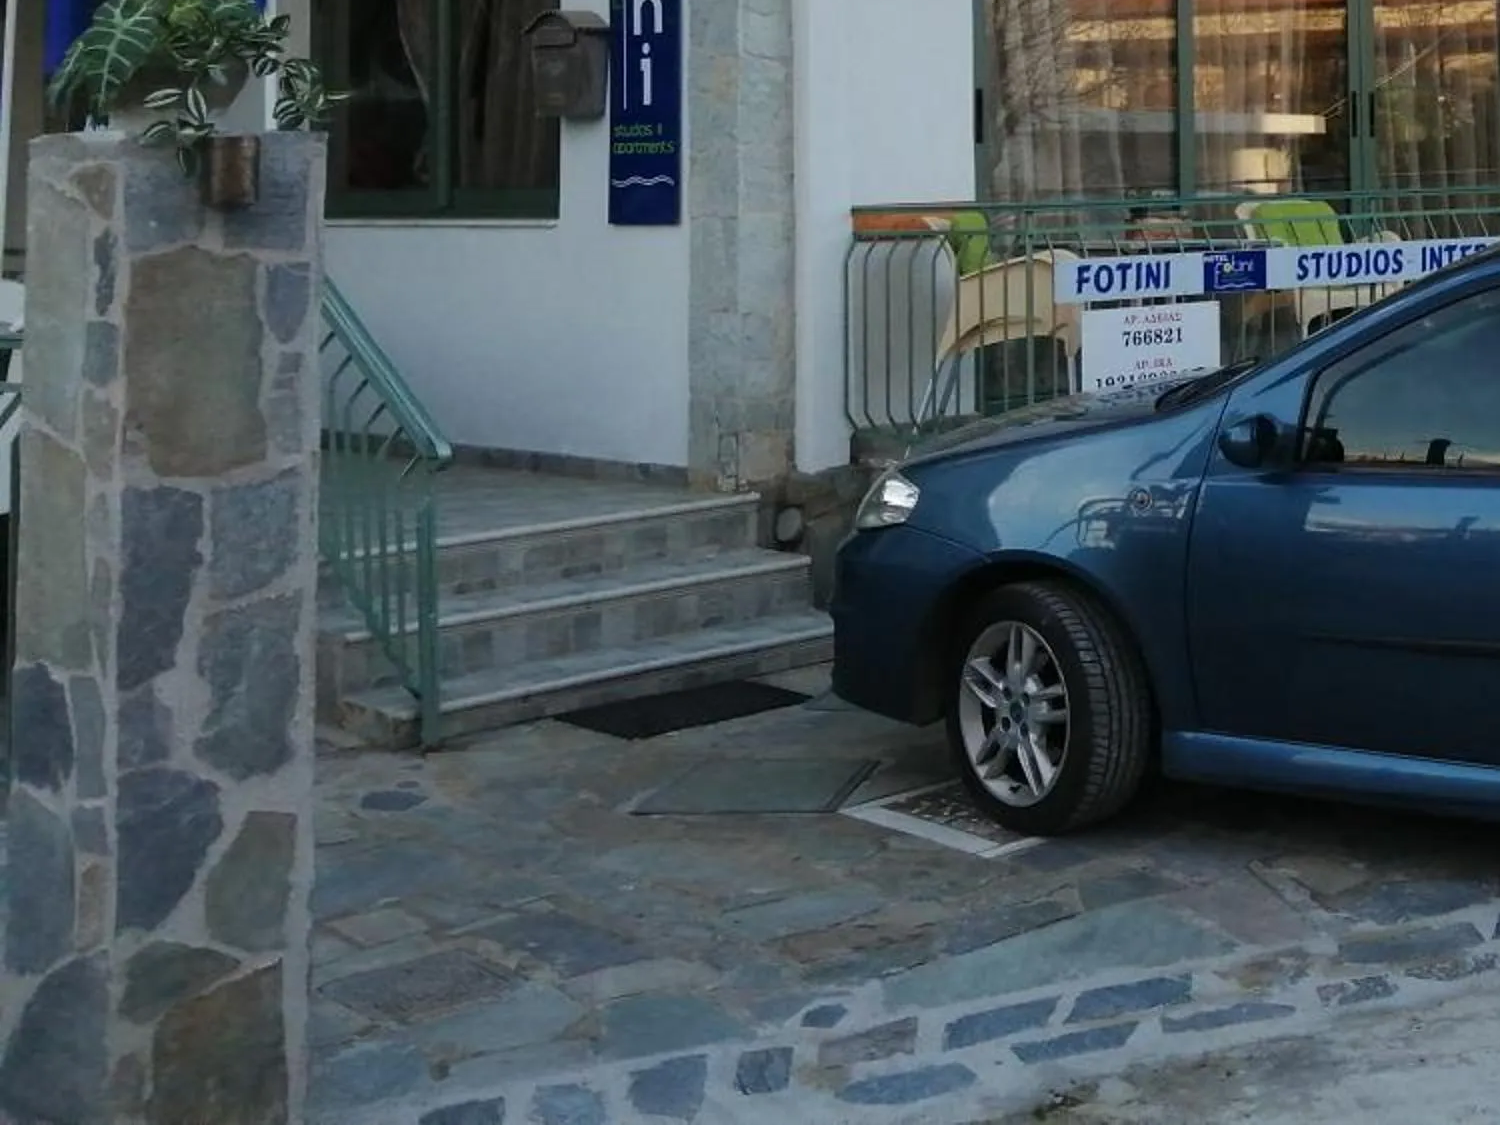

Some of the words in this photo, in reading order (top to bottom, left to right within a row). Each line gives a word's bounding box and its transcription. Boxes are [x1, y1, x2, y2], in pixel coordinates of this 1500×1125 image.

[1076, 261, 1172, 294] FOTINI
[1297, 249, 1404, 281] STUDIOS
[1122, 329, 1184, 347] 766821
